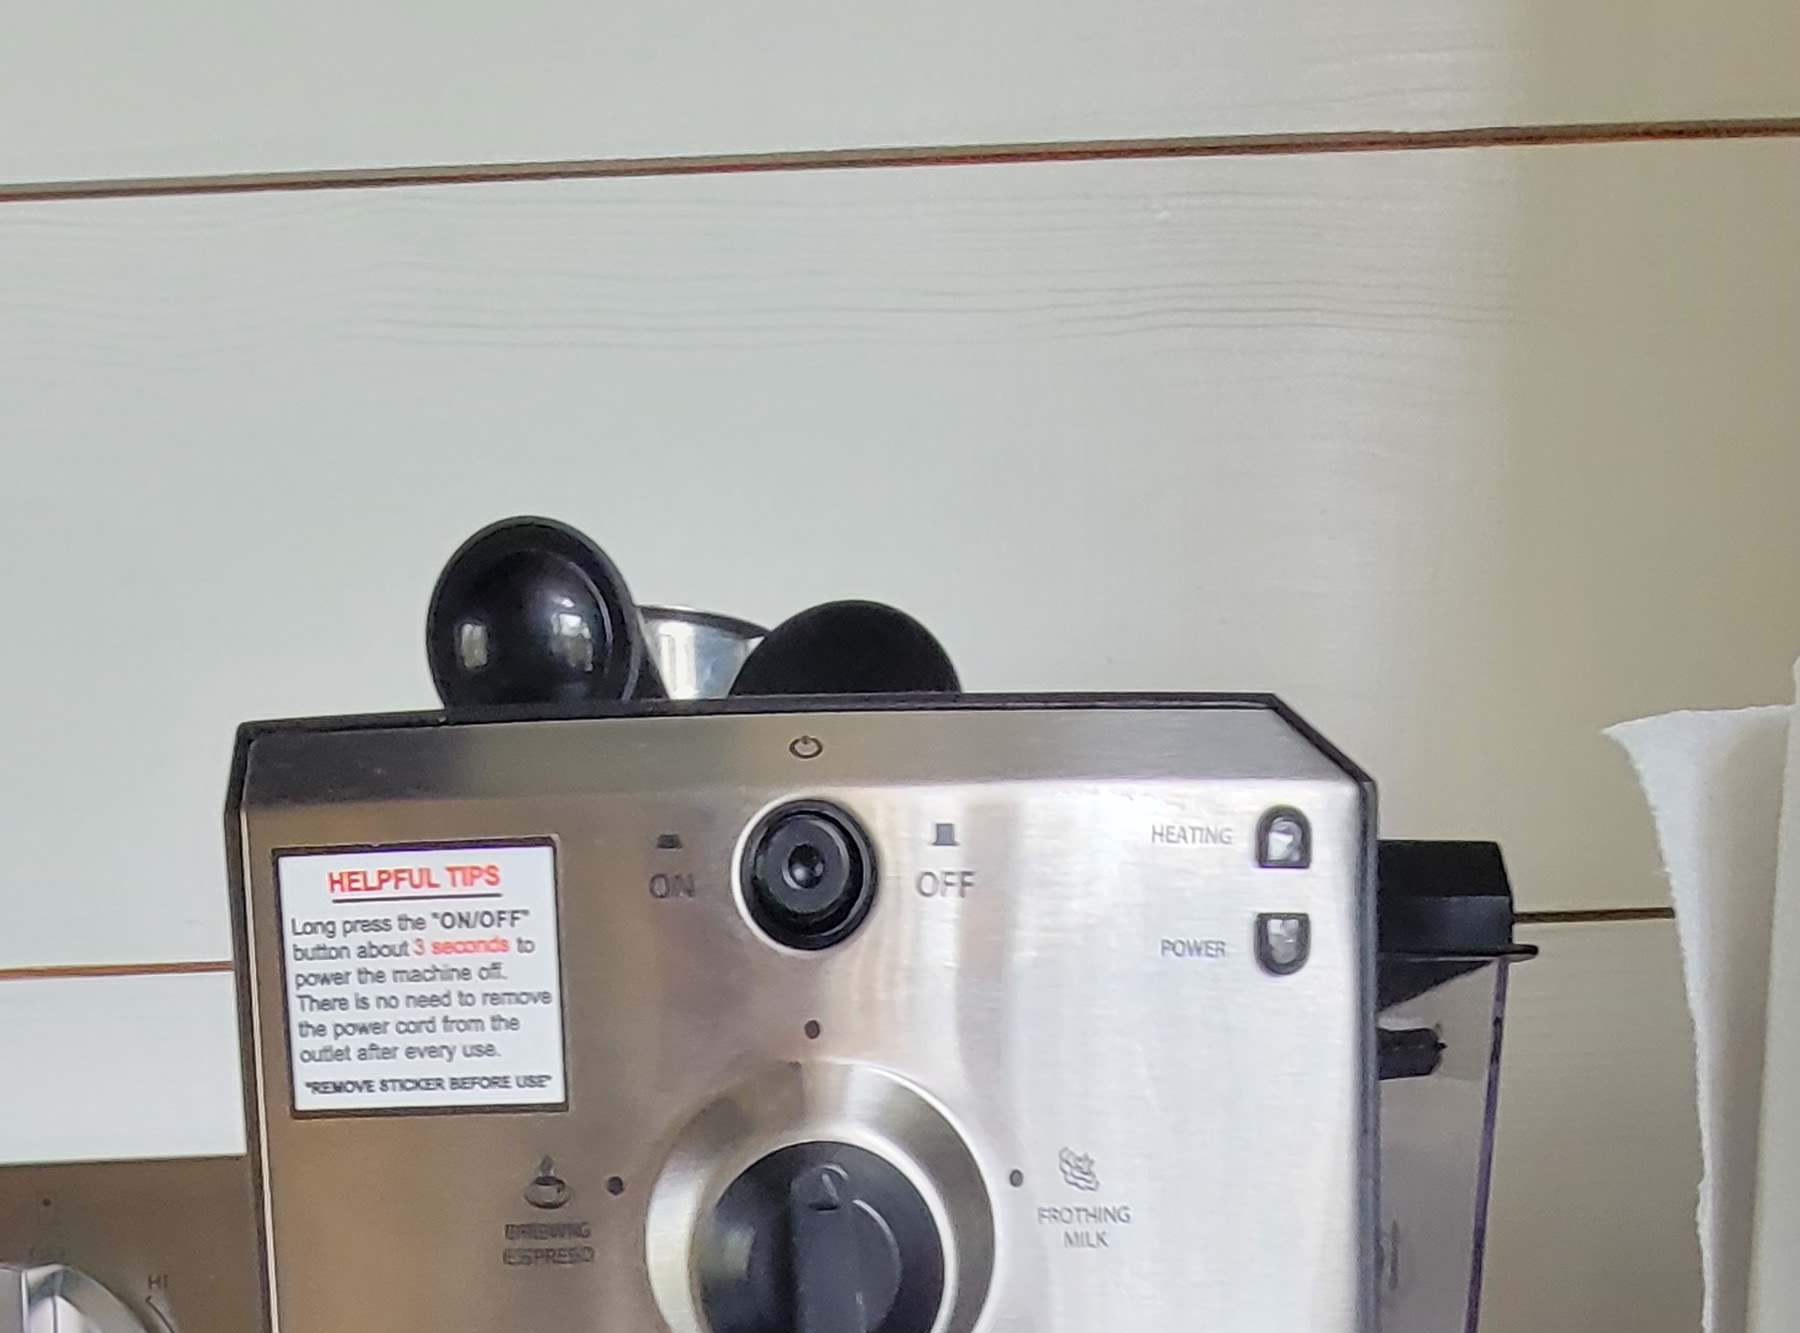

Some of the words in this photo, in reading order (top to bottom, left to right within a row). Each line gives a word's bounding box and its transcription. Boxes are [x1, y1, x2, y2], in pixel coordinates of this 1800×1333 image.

[1151, 824, 1233, 845] HEATING
[328, 868, 440, 893] HELPFUL
[446, 864, 500, 887] TIPS
[648, 872, 696, 899] ON
[915, 870, 977, 898] OFF
[290, 918, 336, 938] Long
[342, 916, 392, 936] press
[398, 914, 426, 930] the
[432, 909, 530, 929] "ON/OFF"
[292, 944, 350, 962] button
[357, 941, 410, 958] about
[414, 938, 426, 956] 3
[432, 936, 510, 955] seconds
[516, 938, 536, 954] to
[1160, 938, 1227, 958] POWER
[295, 969, 351, 990] power
[357, 967, 386, 984] the
[392, 964, 472, 983] machine
[478, 962, 508, 981] off.
[296, 994, 349, 1012] There
[356, 993, 370, 1010] is
[376, 994, 399, 1009] no
[405, 990, 452, 1008] need
[458, 990, 476, 1006] to
[482, 990, 552, 1005] remove
[298, 1020, 327, 1038] the
[334, 1018, 390, 1040] power
[395, 1016, 437, 1034] cord
[442, 1015, 485, 1032] from
[490, 1014, 520, 1032] the
[300, 1045, 352, 1063] outlet
[357, 1043, 398, 1061] after
[405, 1044, 456, 1062] every
[462, 1042, 502, 1058] use.
[380, 1076, 445, 1092] STICKER
[450, 1074, 512, 1090] BEFORE
[1036, 1204, 1132, 1225] FROTHING
[1062, 1230, 1109, 1249] MILK
